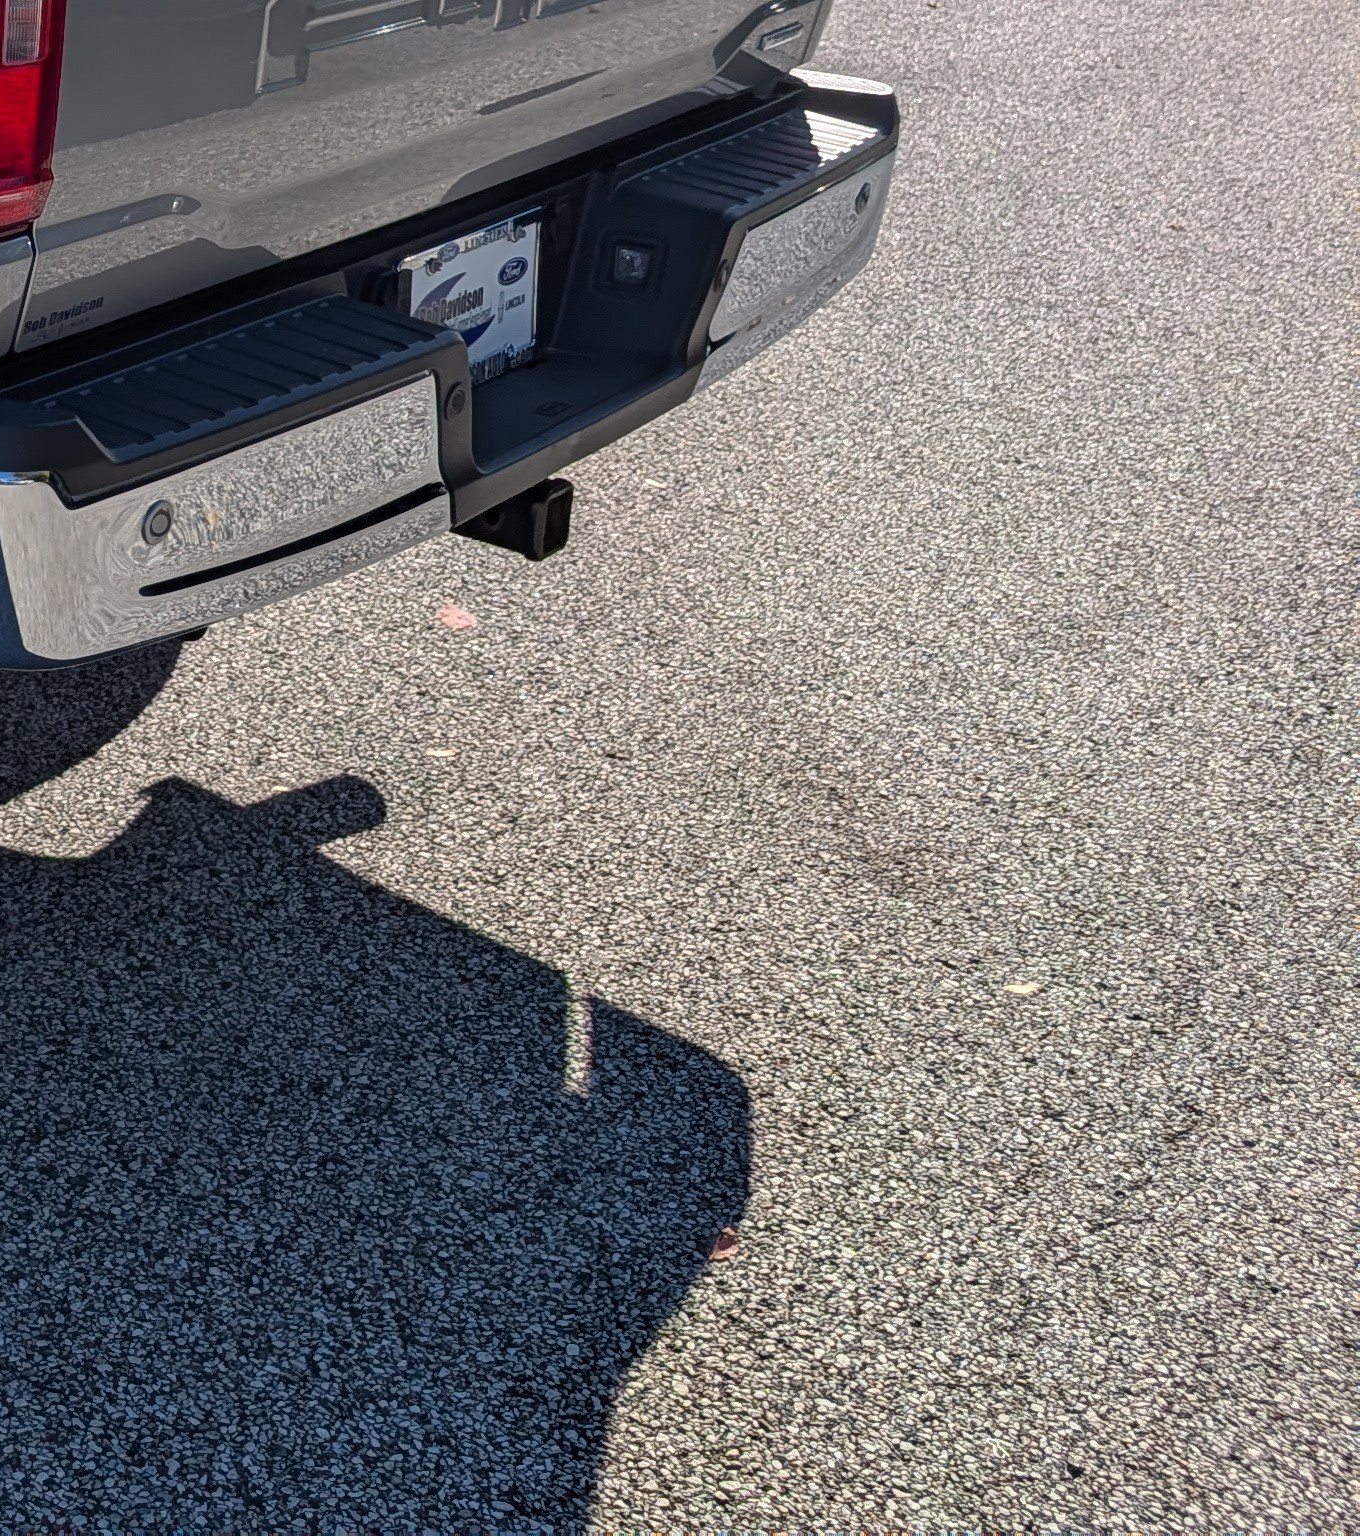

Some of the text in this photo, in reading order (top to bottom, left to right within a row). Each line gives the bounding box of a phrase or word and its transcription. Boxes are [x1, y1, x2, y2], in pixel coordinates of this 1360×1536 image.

[23, 315, 48, 335] Bob
[49, 296, 104, 326] Davidson
[441, 286, 483, 321] Davidson
